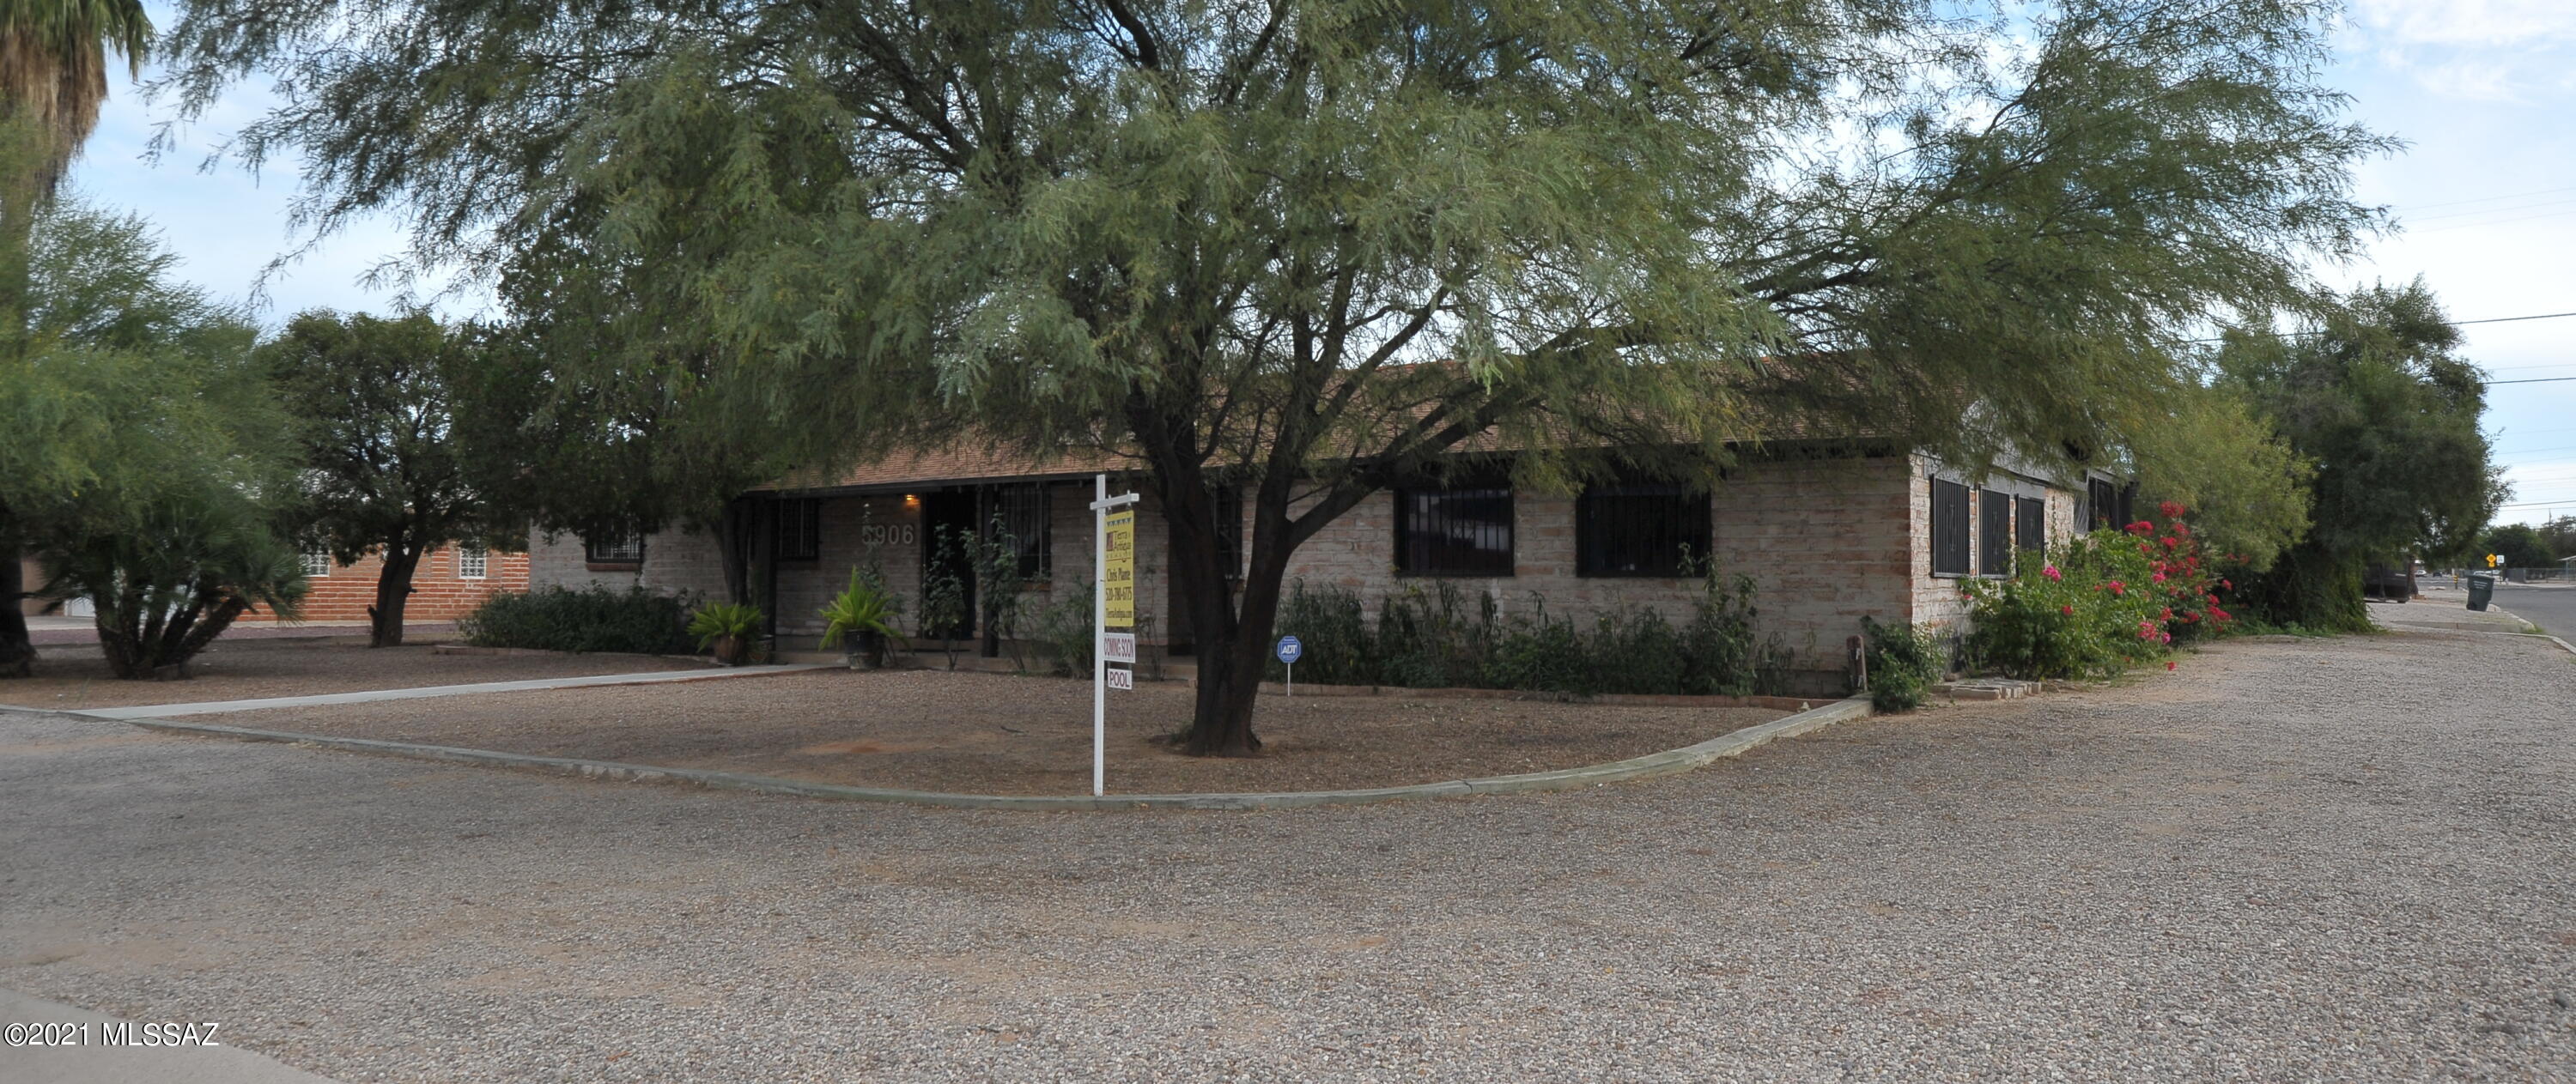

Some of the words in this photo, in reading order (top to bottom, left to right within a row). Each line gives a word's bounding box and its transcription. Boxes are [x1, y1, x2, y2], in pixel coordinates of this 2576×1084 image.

[861, 524, 914, 544] 5906
[1104, 638, 1121, 657] COMING
[1121, 639, 1134, 657] SOON
[1281, 645, 1297, 654] ADT
[1109, 671, 1130, 687] POOL
